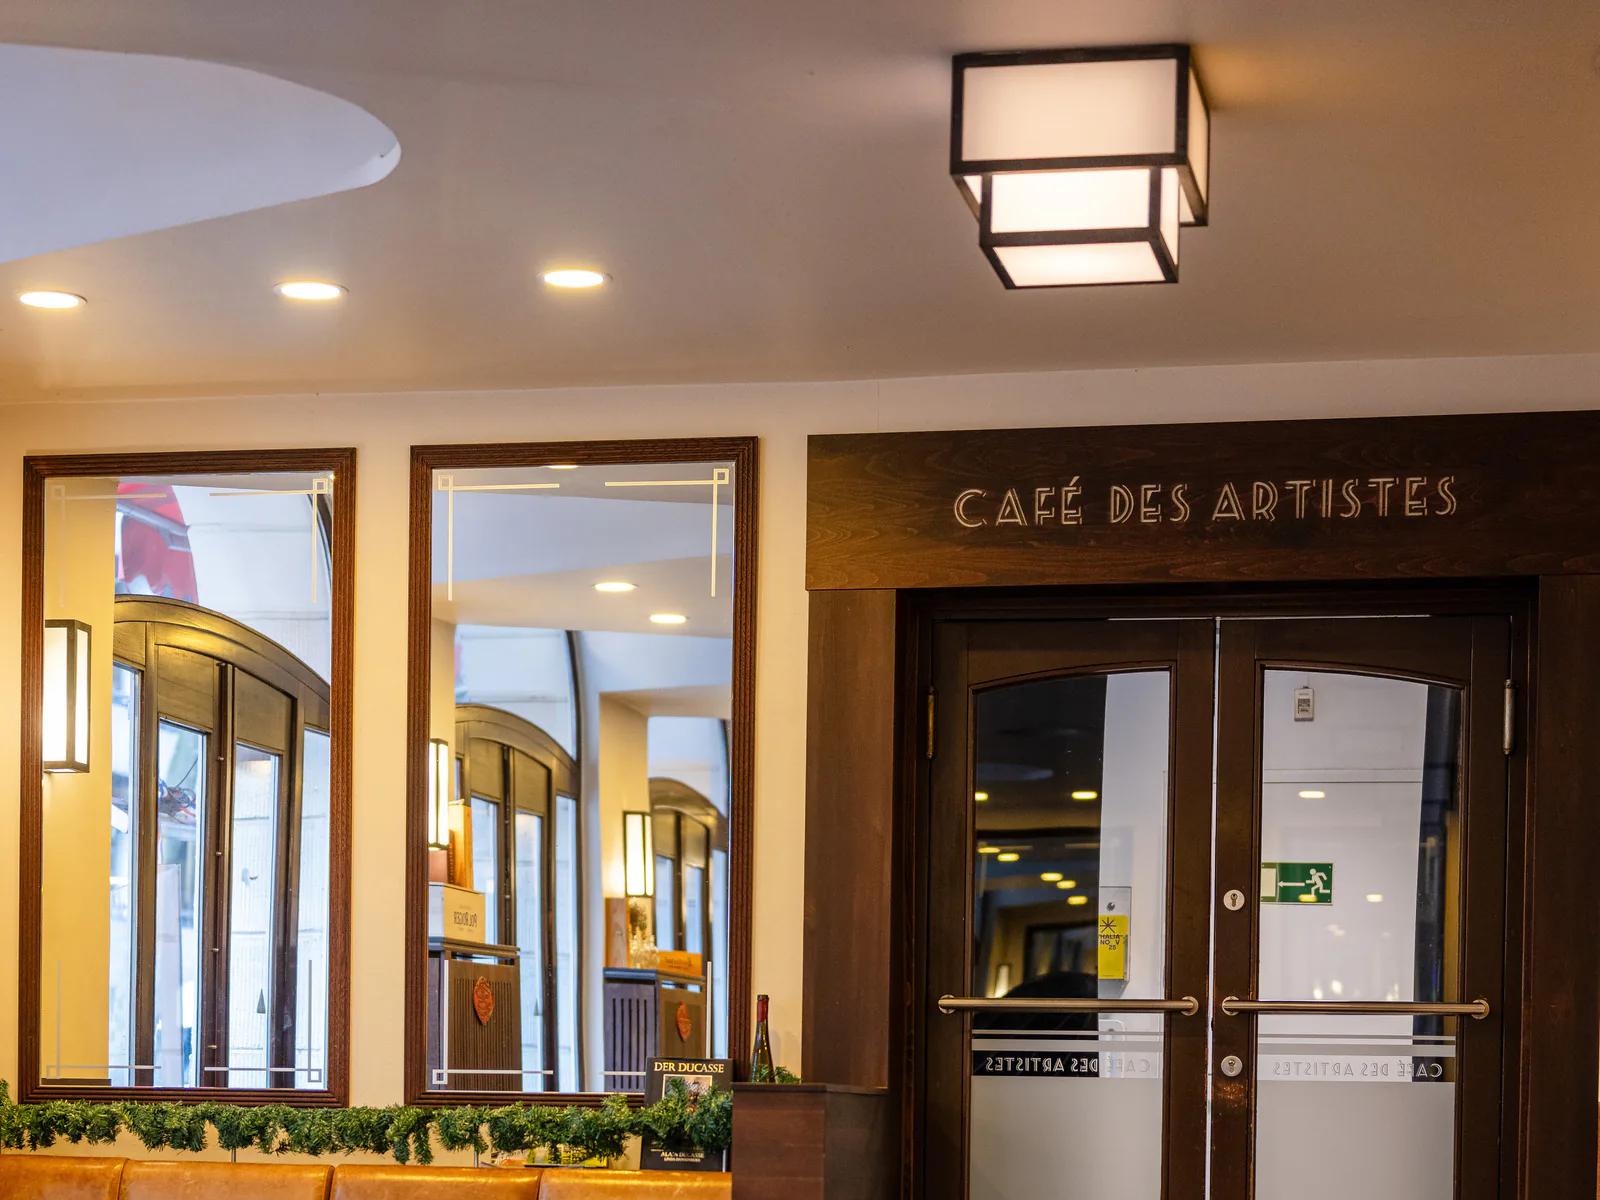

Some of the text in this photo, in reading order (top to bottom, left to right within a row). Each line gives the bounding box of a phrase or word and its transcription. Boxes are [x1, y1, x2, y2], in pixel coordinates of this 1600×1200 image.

[953, 475, 1458, 528] CAFÉ DES ARTISTES
[653, 1061, 725, 1074] DER DUCASSE
